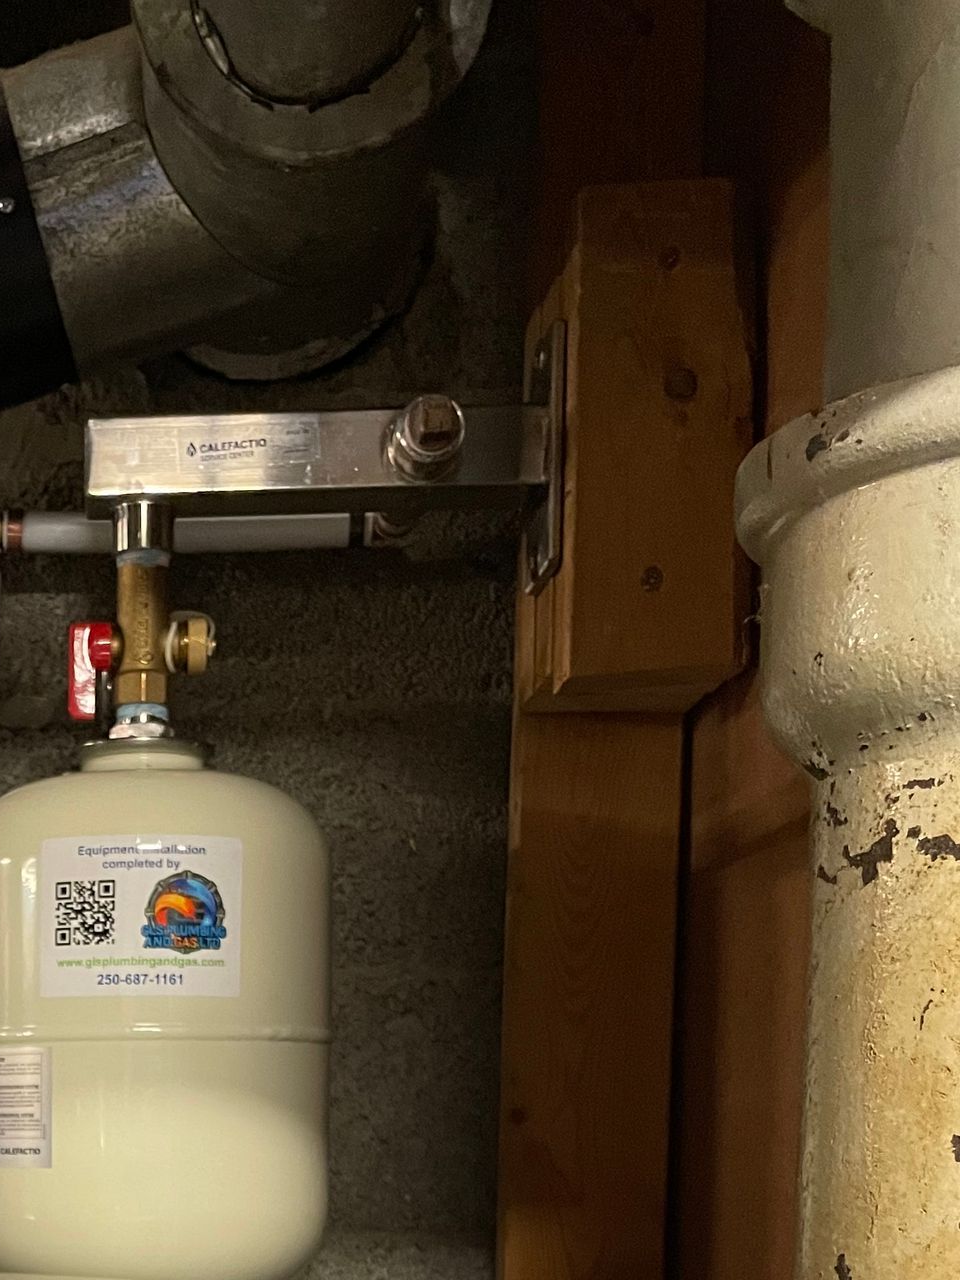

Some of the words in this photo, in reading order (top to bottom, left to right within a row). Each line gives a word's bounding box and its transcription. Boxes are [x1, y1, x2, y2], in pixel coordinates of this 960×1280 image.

[199, 438, 267, 453] CALEFACTIO
[102, 859, 163, 871] completed
[167, 859, 180, 871] by
[142, 926, 164, 937] GLS
[168, 925, 227, 938] PLUMBING
[144, 937, 171, 948] AND
[174, 937, 197, 949] GAS
[199, 937, 221, 948] LTD
[57, 957, 226, 969] www.glsplumbingandgas.com
[97, 974, 184, 986] 250-687-1161
